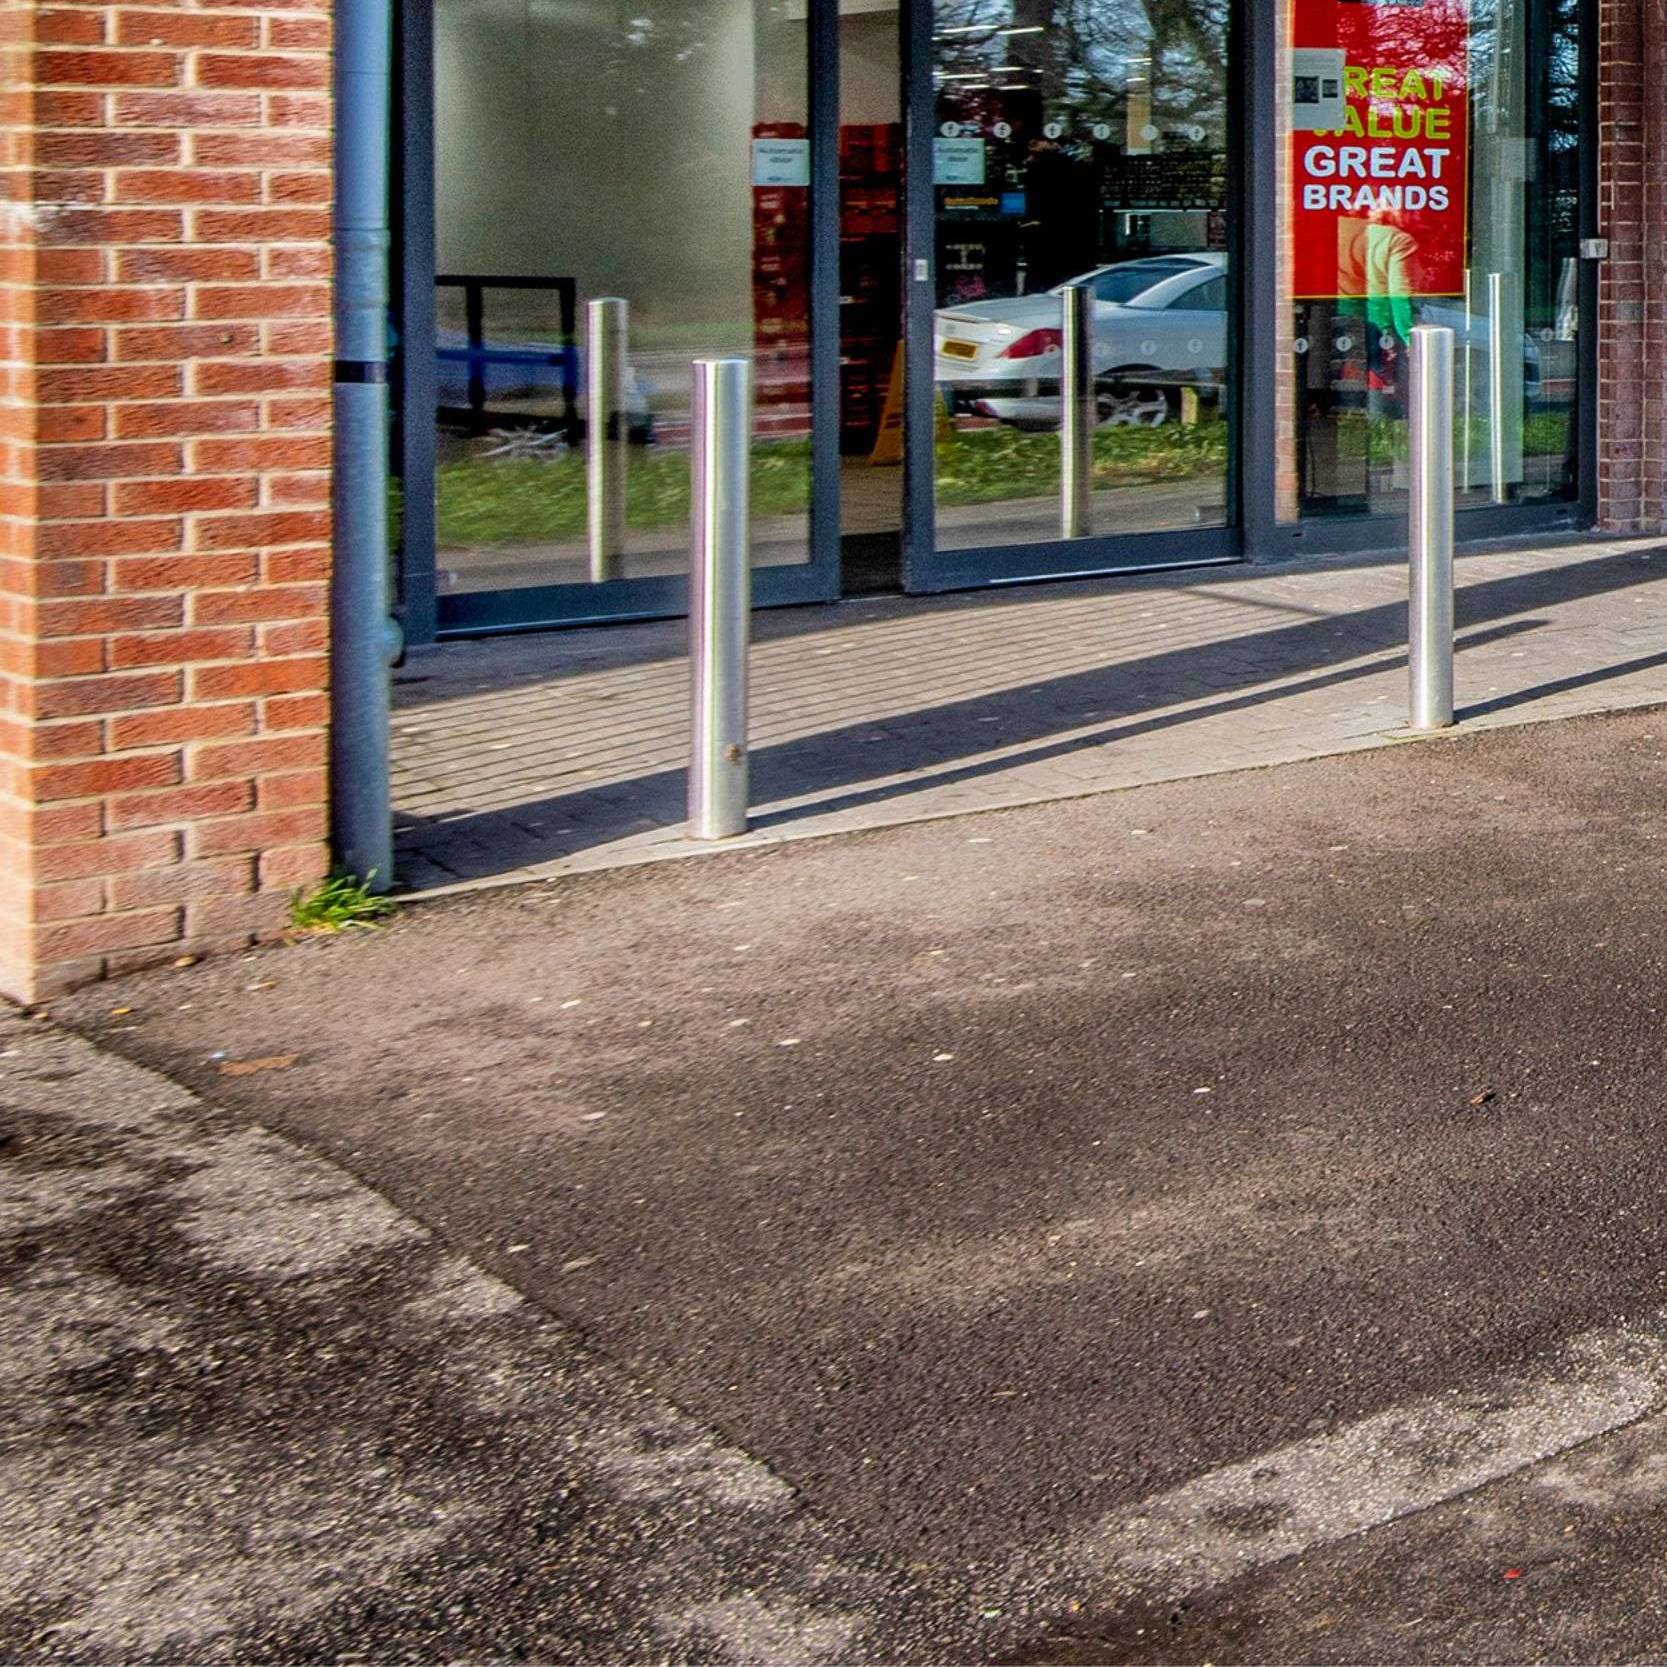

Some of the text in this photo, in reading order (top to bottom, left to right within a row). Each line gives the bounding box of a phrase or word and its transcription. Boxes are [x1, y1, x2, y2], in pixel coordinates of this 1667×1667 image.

[1344, 66, 1450, 101] REAT
[1313, 105, 1451, 140] ALUE
[1304, 145, 1450, 179] GREAT
[1303, 184, 1450, 211] BRANDS
